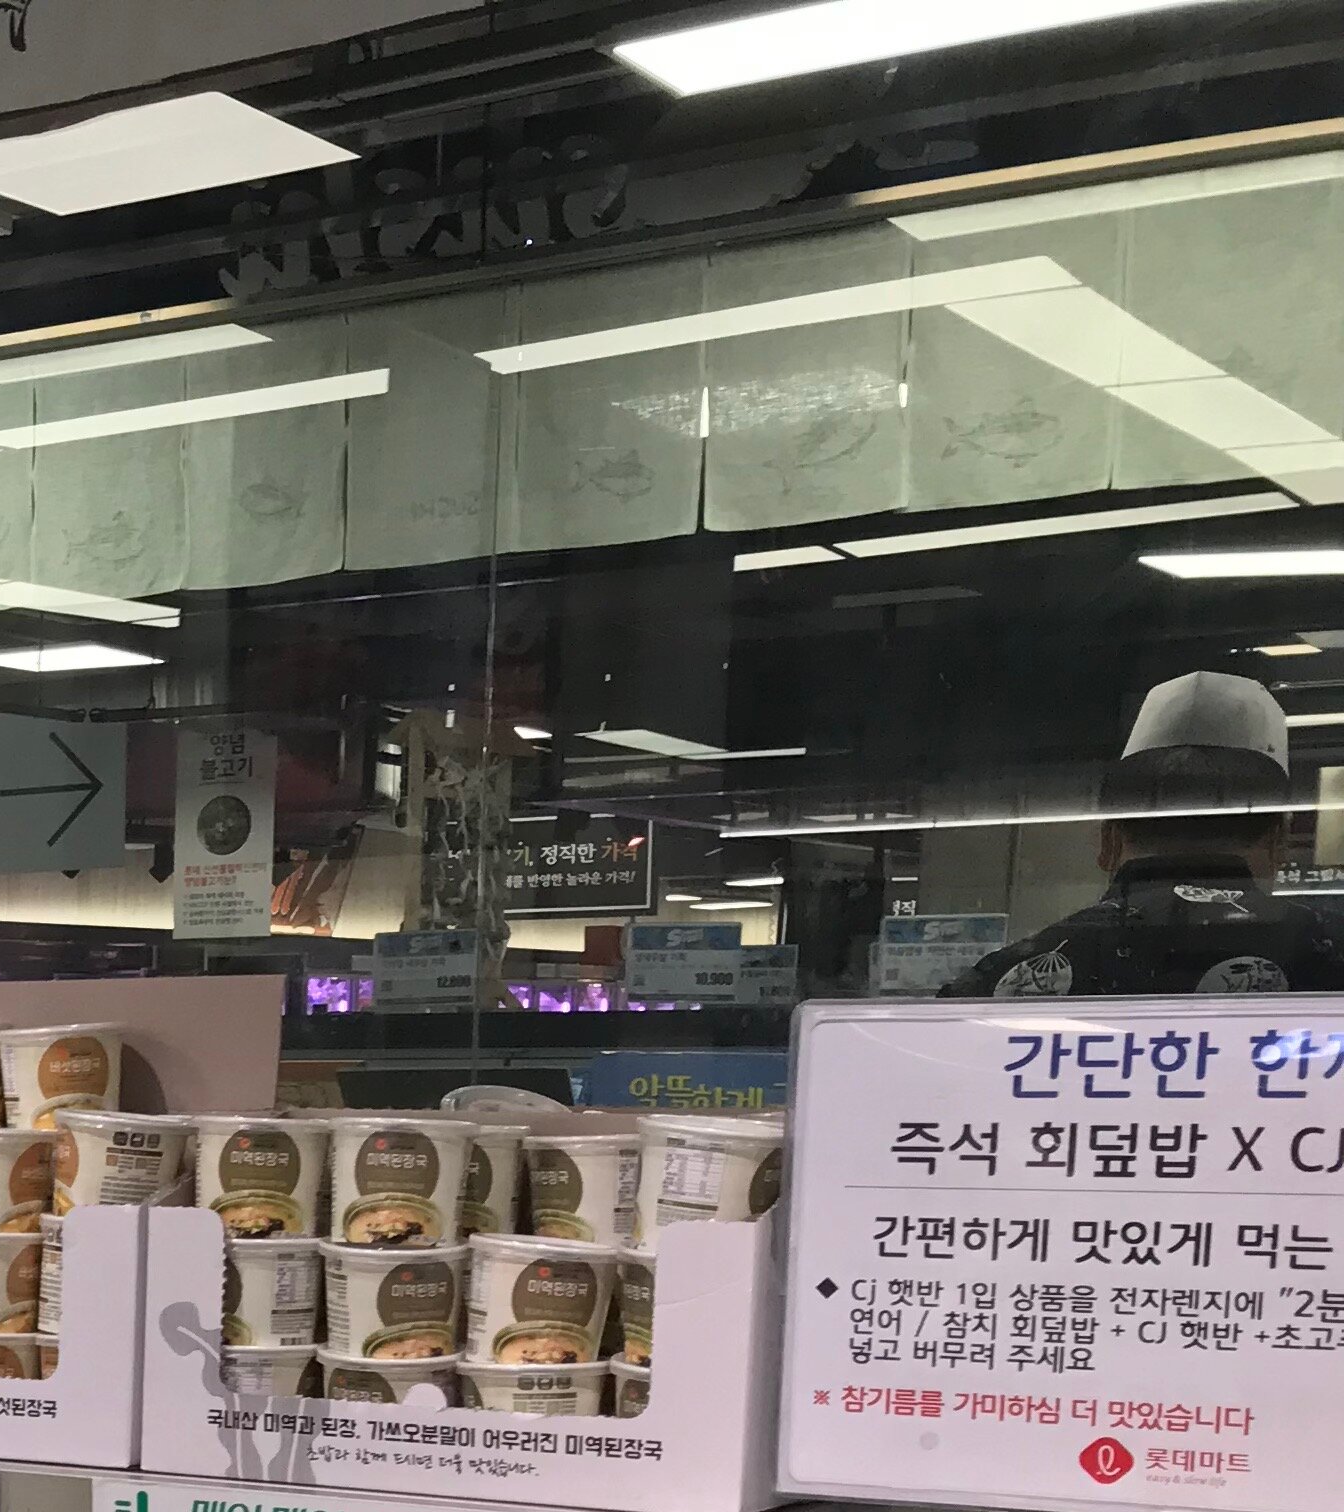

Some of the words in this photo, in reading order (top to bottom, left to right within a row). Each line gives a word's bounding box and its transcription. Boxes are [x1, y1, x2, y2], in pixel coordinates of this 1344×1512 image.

[540, 843, 597, 865] 정직한
[1004, 1031, 1219, 1099] 간단한
[890, 1122, 1000, 1177] 즉석
[1025, 1121, 1207, 1179] 회덮밥
[873, 1215, 1050, 1264] 간편하게
[1072, 1219, 1213, 1268] 맛있게
[1236, 1222, 1333, 1272] 먹는
[887, 1278, 945, 1309] 햇반
[1010, 1283, 1098, 1315] 상품을
[1110, 1287, 1264, 1321] 전자렌지에
[850, 1309, 901, 1337] 연어
[943, 1311, 998, 1340] 참치
[1012, 1315, 1098, 1346] 회덮밥
[1138, 1320, 1167, 1345] CJ
[1180, 1320, 1242, 1352] 햇반
[849, 1337, 901, 1364] 넣고
[912, 1341, 996, 1371] 버무려
[1007, 1345, 1095, 1374] 주세요
[207, 1409, 258, 1431] 국내산
[264, 1412, 316, 1436] 미역과
[483, 1424, 559, 1456] 어우러진
[565, 1431, 664, 1462] 미역된장국
[953, 1390, 1061, 1426] 가미하심
[1071, 1397, 1098, 1427] 더
[1108, 1400, 1255, 1437] 맛있습니다
[1145, 1448, 1253, 1475] 롯데마트
